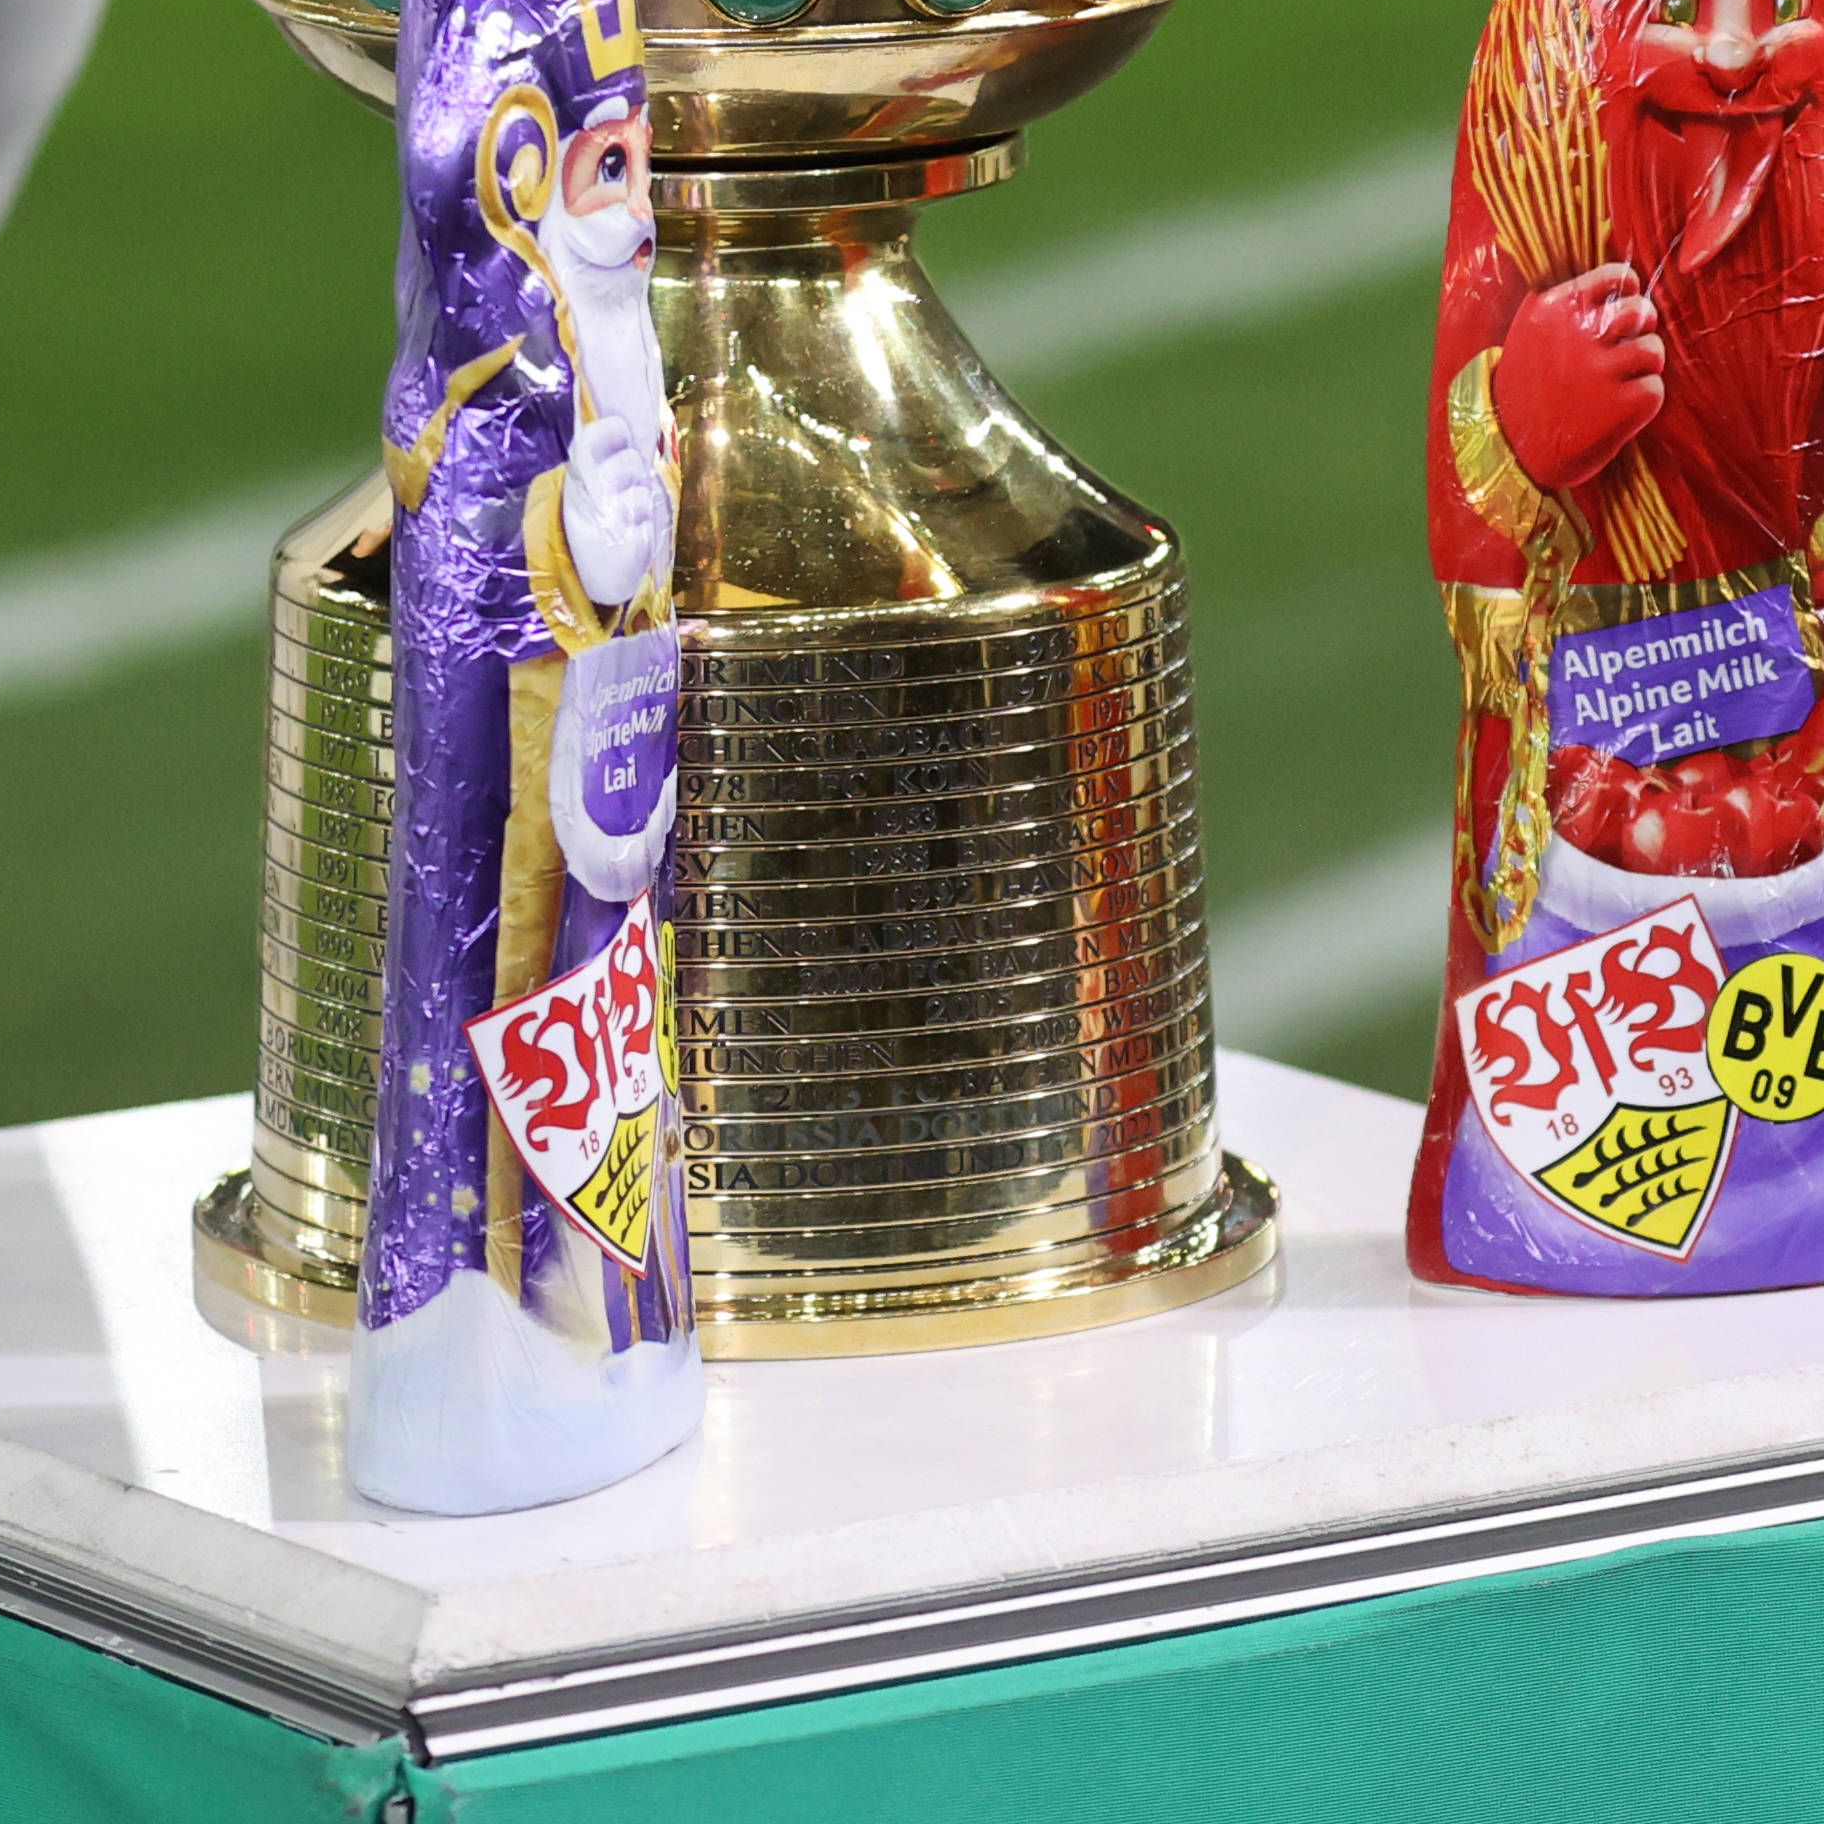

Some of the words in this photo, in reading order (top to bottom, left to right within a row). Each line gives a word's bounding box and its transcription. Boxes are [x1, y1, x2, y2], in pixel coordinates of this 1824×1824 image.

[1563, 610, 1769, 684] Alpenmilch
[1575, 681, 1694, 728] Alpine
[1697, 652, 1780, 700] Milk
[1650, 709, 1721, 754] Lait
[632, 1073, 649, 1102] 93
[1658, 1067, 1694, 1097] 93
[1749, 1069, 1797, 1108] 09
[1545, 1112, 1580, 1141] 18
[578, 1130, 601, 1161] 18
